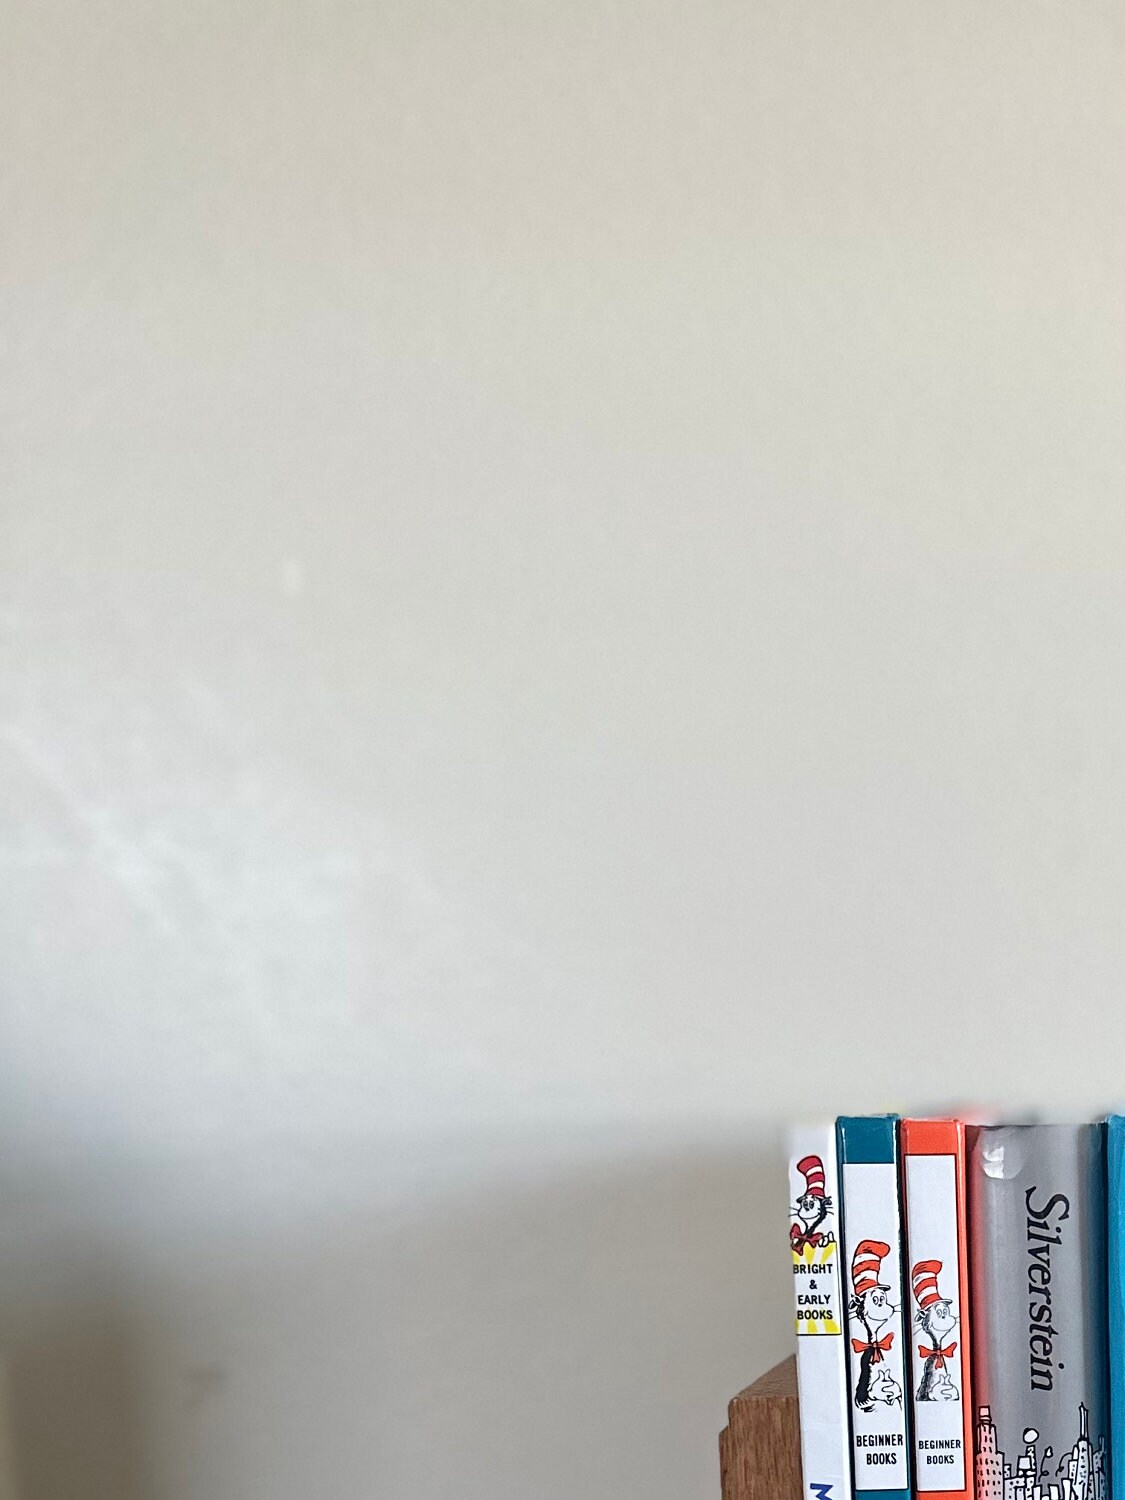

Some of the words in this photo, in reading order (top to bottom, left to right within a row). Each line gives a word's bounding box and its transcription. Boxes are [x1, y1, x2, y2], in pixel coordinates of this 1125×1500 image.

[793, 1263, 833, 1275] BRIGHT
[809, 1279, 818, 1290] &
[1025, 1186, 1070, 1392] Silverstein
[798, 1295, 830, 1305] EARLY
[796, 1310, 833, 1320] BOOKS
[856, 1434, 904, 1447] BEGINNER
[918, 1439, 961, 1450] BEGINNER
[866, 1453, 897, 1465] BOOKS
[926, 1455, 955, 1465] BOOKS
